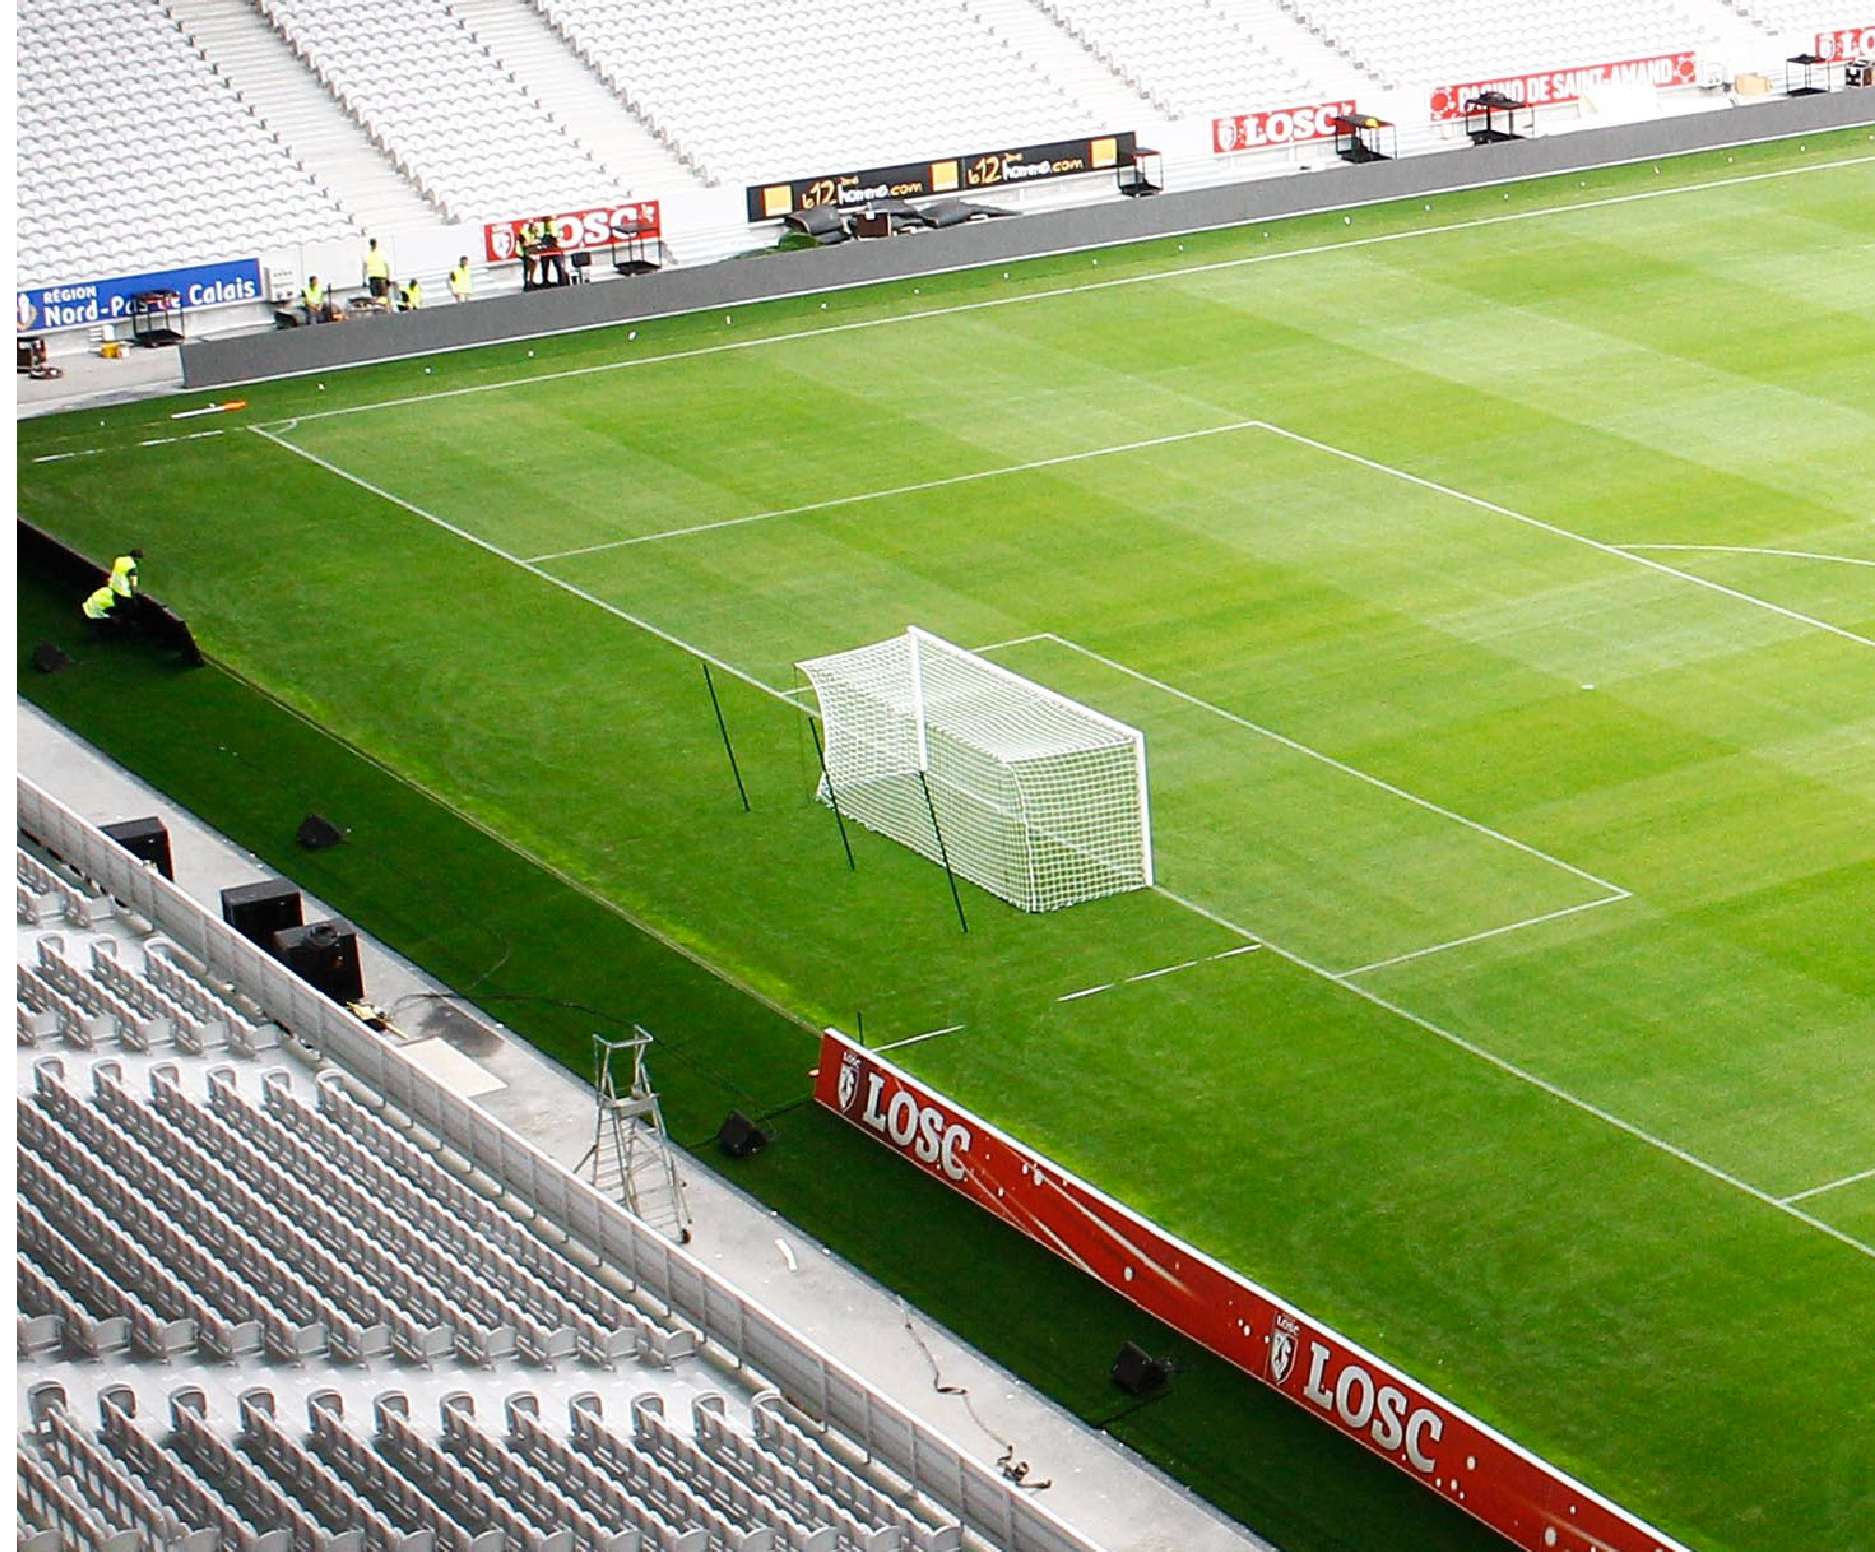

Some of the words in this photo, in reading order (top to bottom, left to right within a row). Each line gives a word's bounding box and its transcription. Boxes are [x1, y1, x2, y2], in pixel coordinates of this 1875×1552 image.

[1527, 75, 1551, 102] DE
[1241, 104, 1338, 147] LOSC
[43, 285, 98, 305] RÉGION
[189, 276, 256, 305] Calais
[862, 1071, 971, 1180] LOSC
[1303, 1341, 1444, 1473] LOSC
